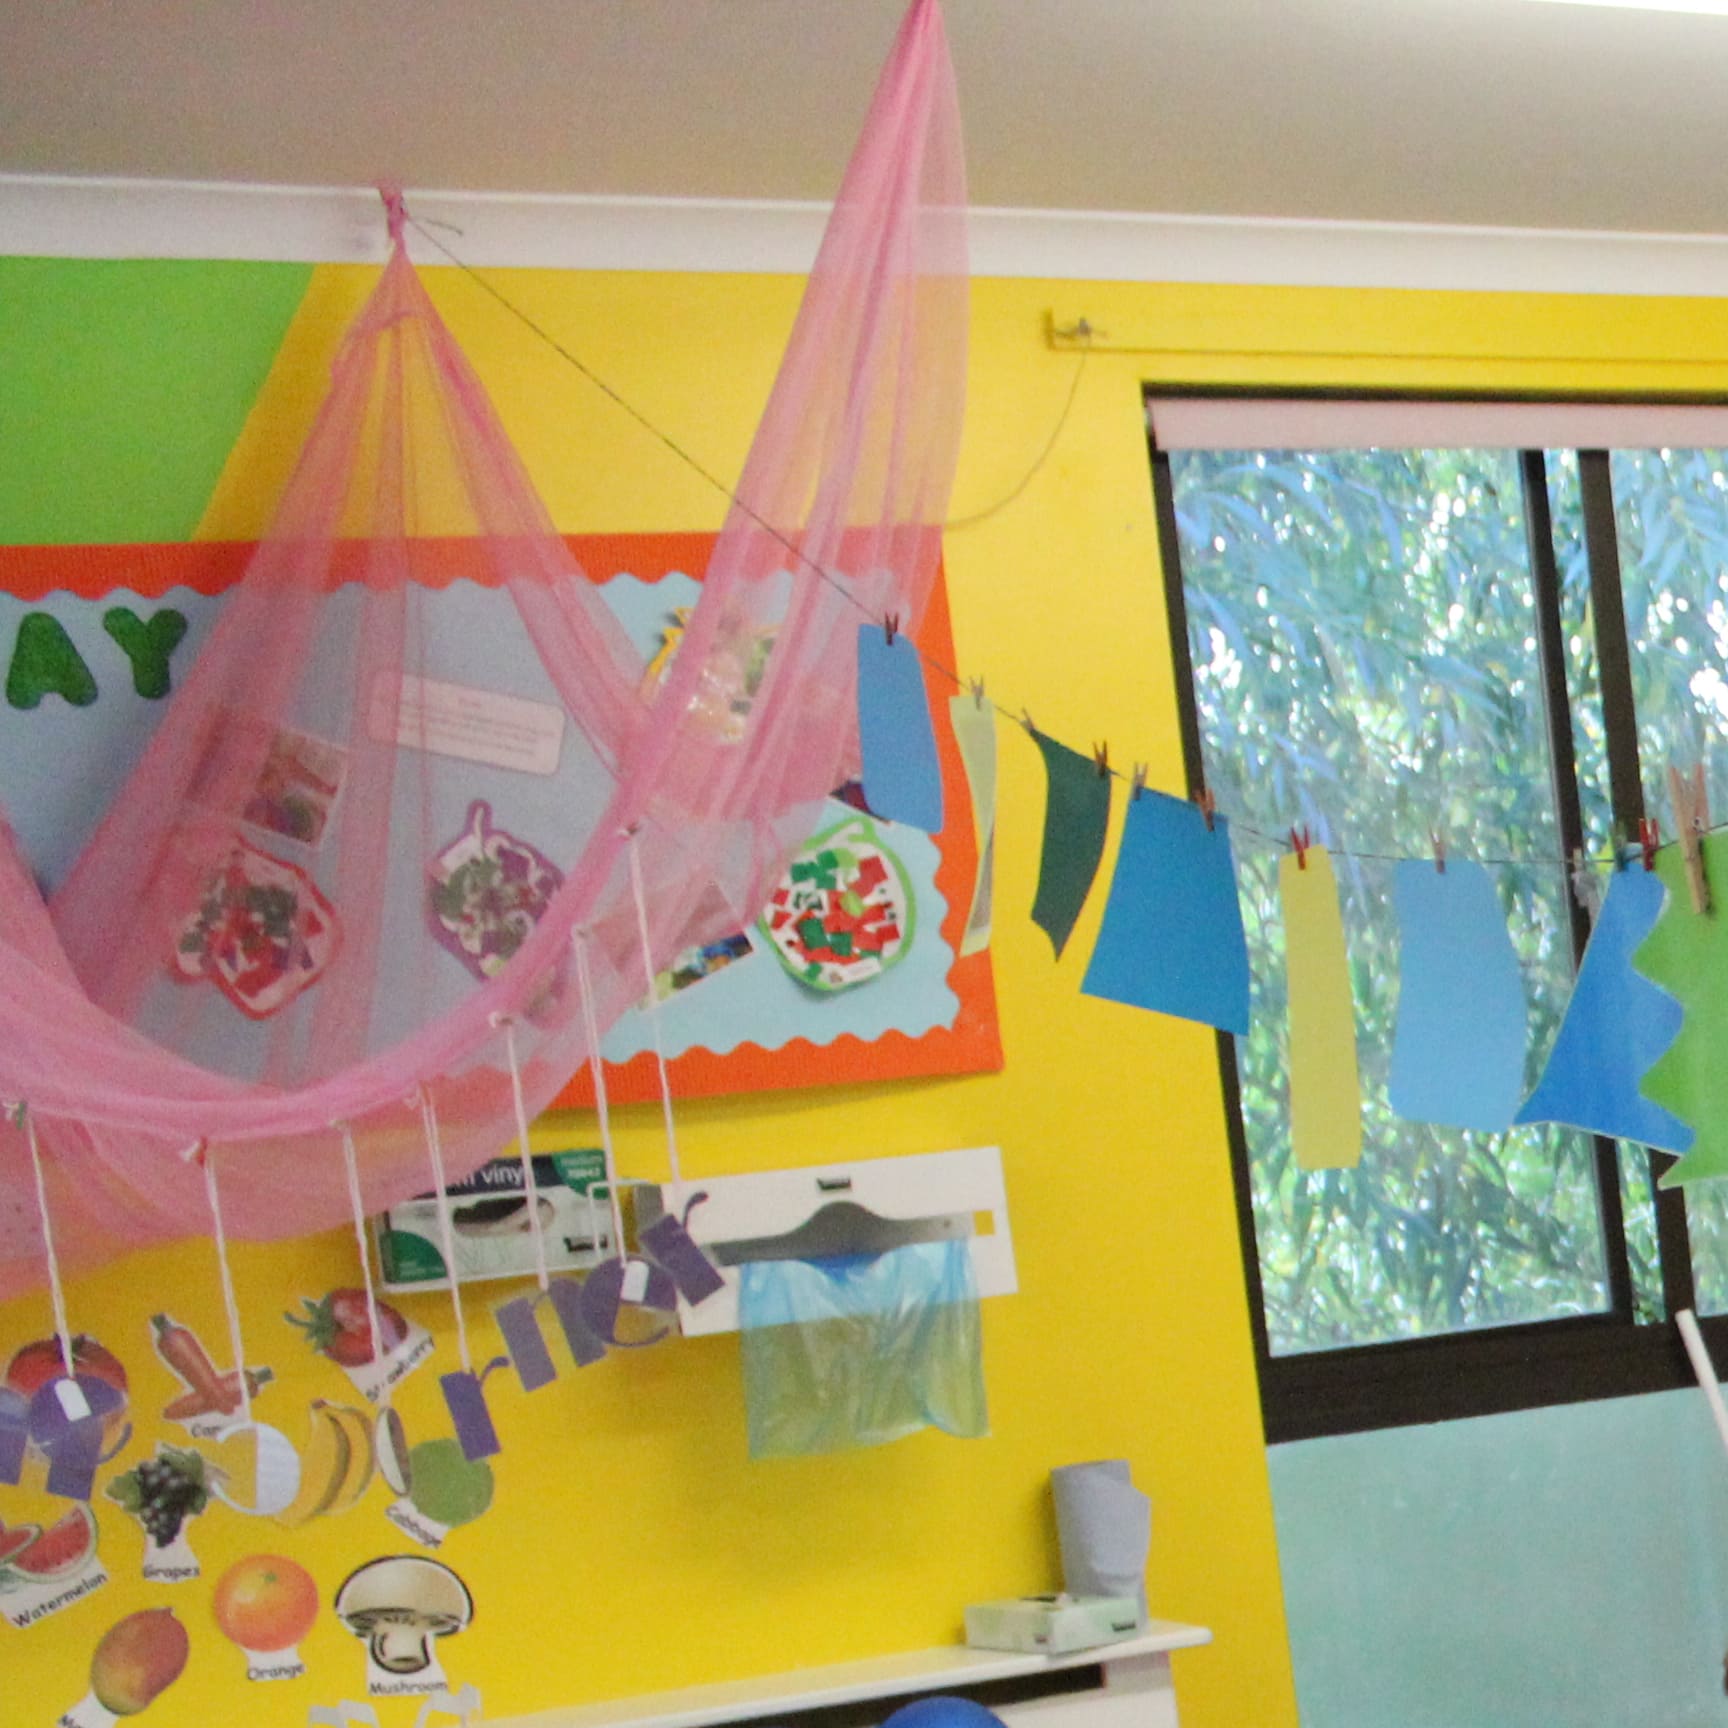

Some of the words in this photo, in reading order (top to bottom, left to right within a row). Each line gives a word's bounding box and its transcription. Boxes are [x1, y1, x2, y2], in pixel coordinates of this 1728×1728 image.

[480, 1165, 527, 1188] viny
[143, 1565, 200, 1582] Grapes
[12, 1571, 108, 1629] Watermelon
[246, 1663, 305, 1683] Orange
[368, 1680, 449, 1697] Mushroom
